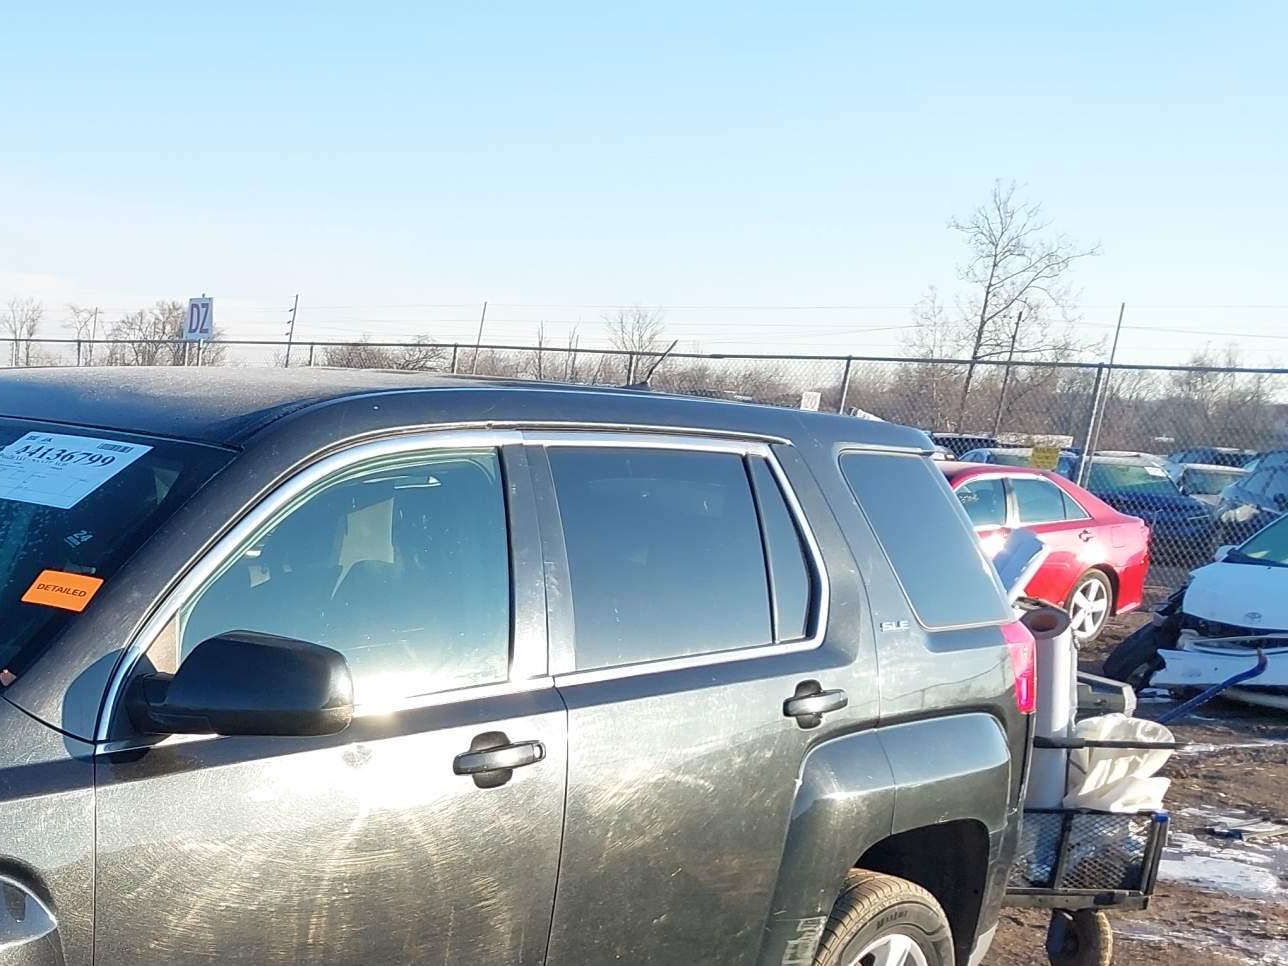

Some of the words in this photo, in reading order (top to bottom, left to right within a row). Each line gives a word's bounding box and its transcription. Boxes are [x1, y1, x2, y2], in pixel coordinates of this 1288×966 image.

[188, 303, 209, 333] DZ
[15, 444, 116, 467] 44136799
[36, 583, 87, 598] DETAILED
[880, 620, 910, 632] SLE
